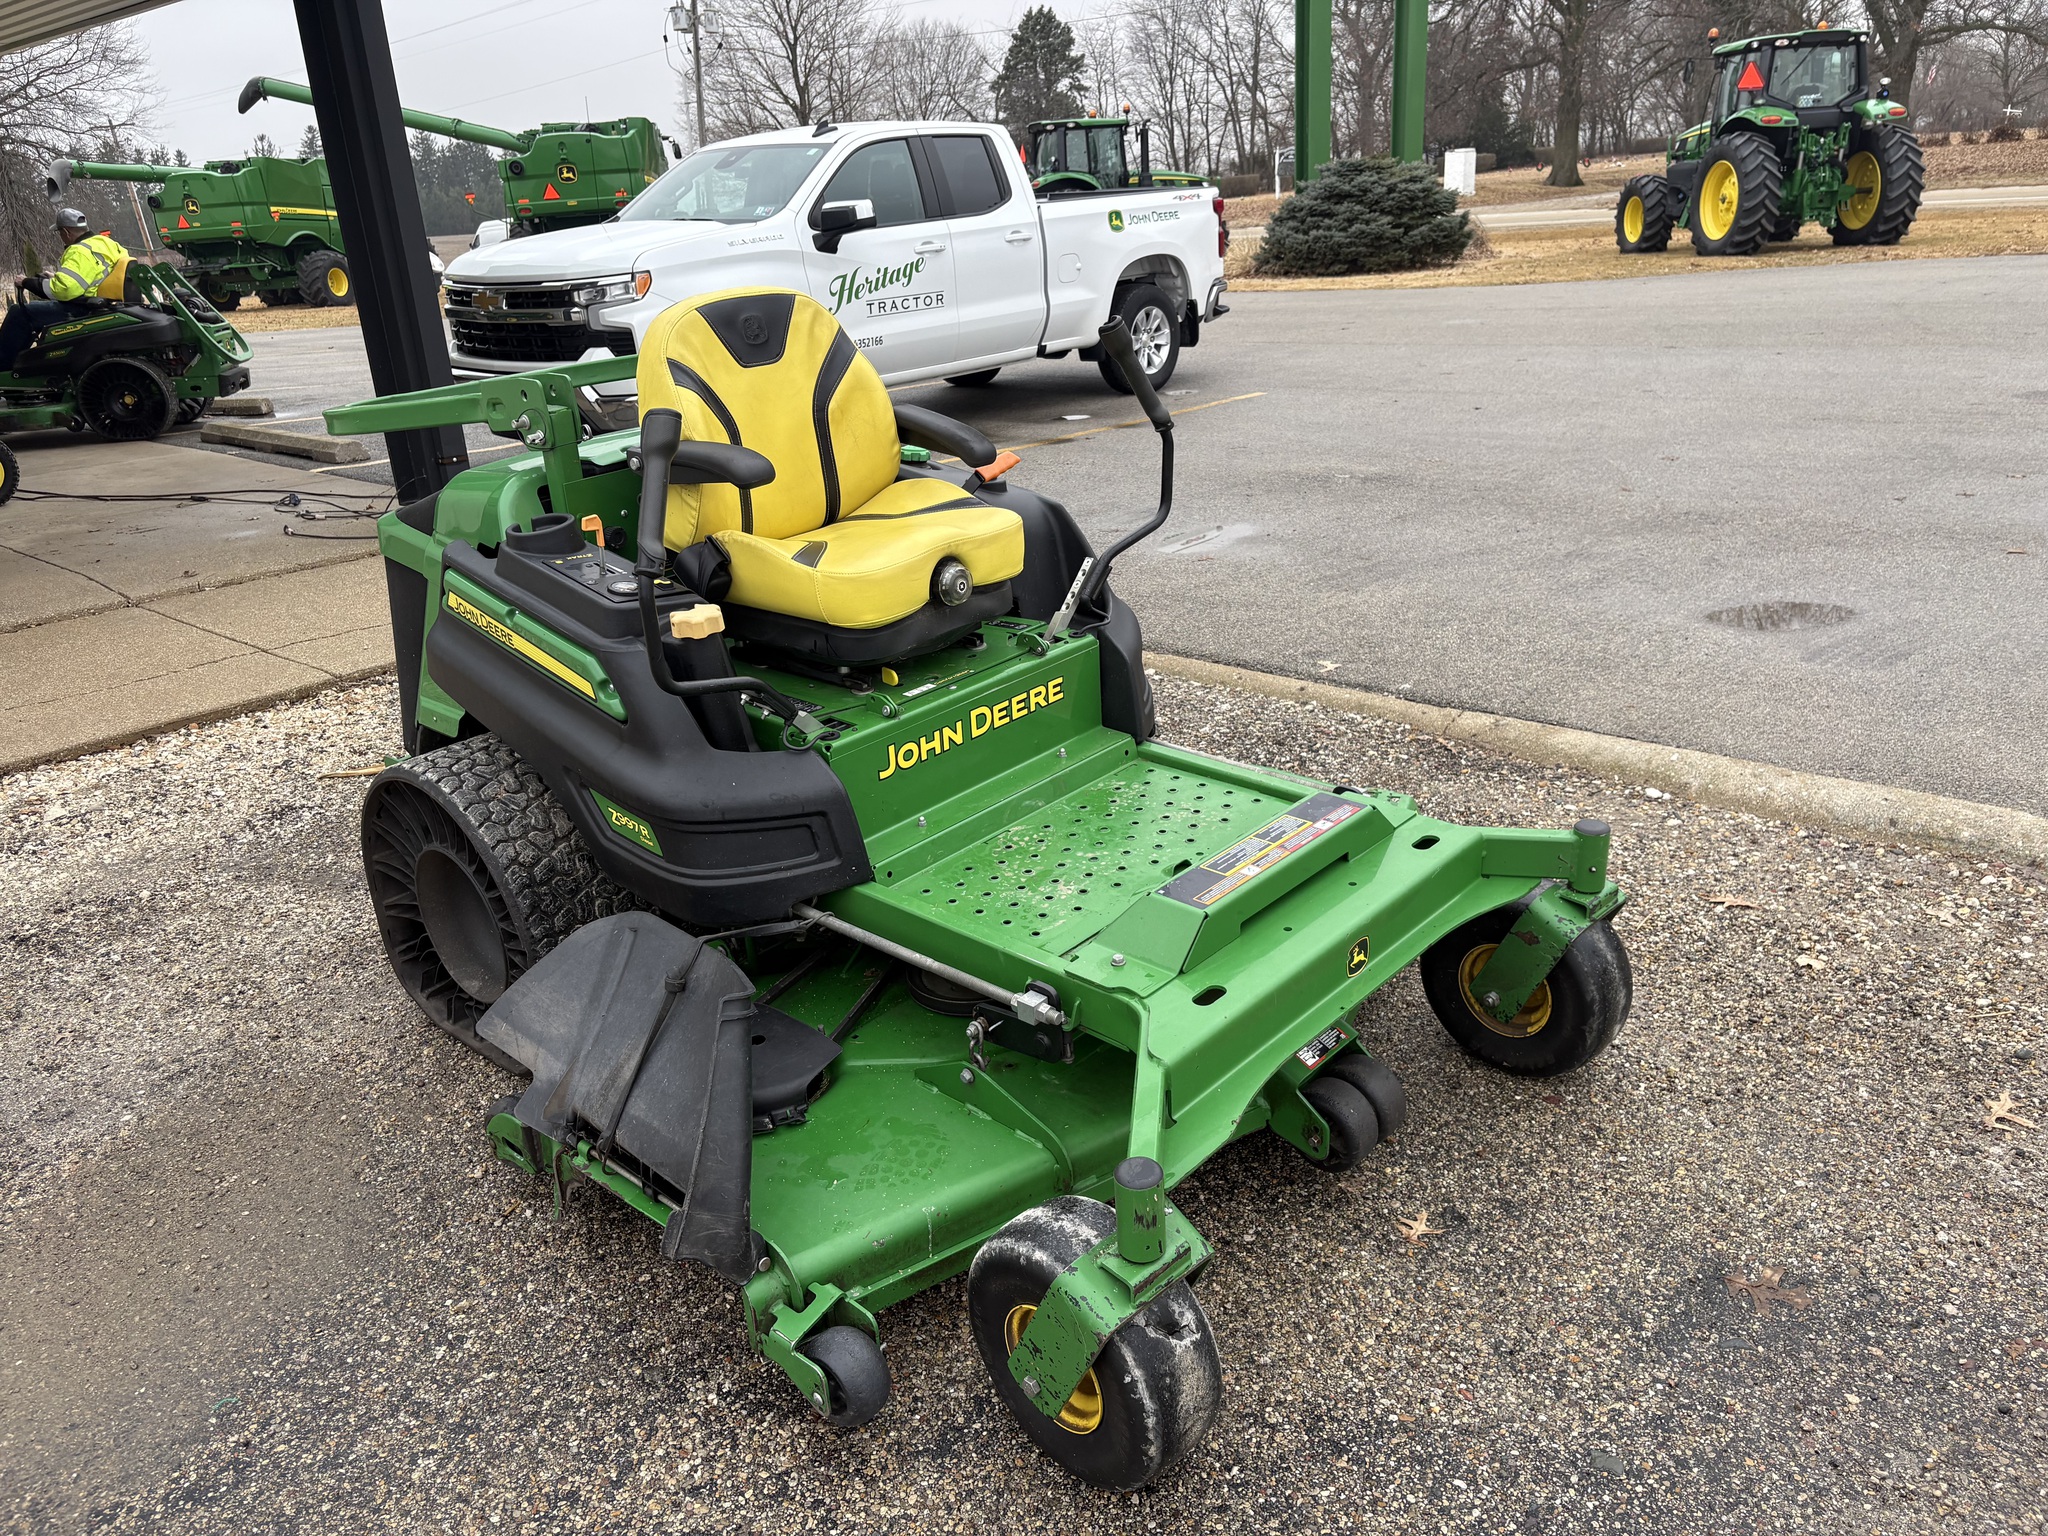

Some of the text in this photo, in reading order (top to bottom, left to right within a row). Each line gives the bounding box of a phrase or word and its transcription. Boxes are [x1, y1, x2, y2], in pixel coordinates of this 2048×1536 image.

[1128, 210, 1180, 226] JOHN DEERE
[828, 256, 927, 316] Heritage
[866, 293, 945, 315] TRACTOR
[453, 597, 516, 648] JOHN DEERE
[878, 675, 1065, 782] JOHN DEERE
